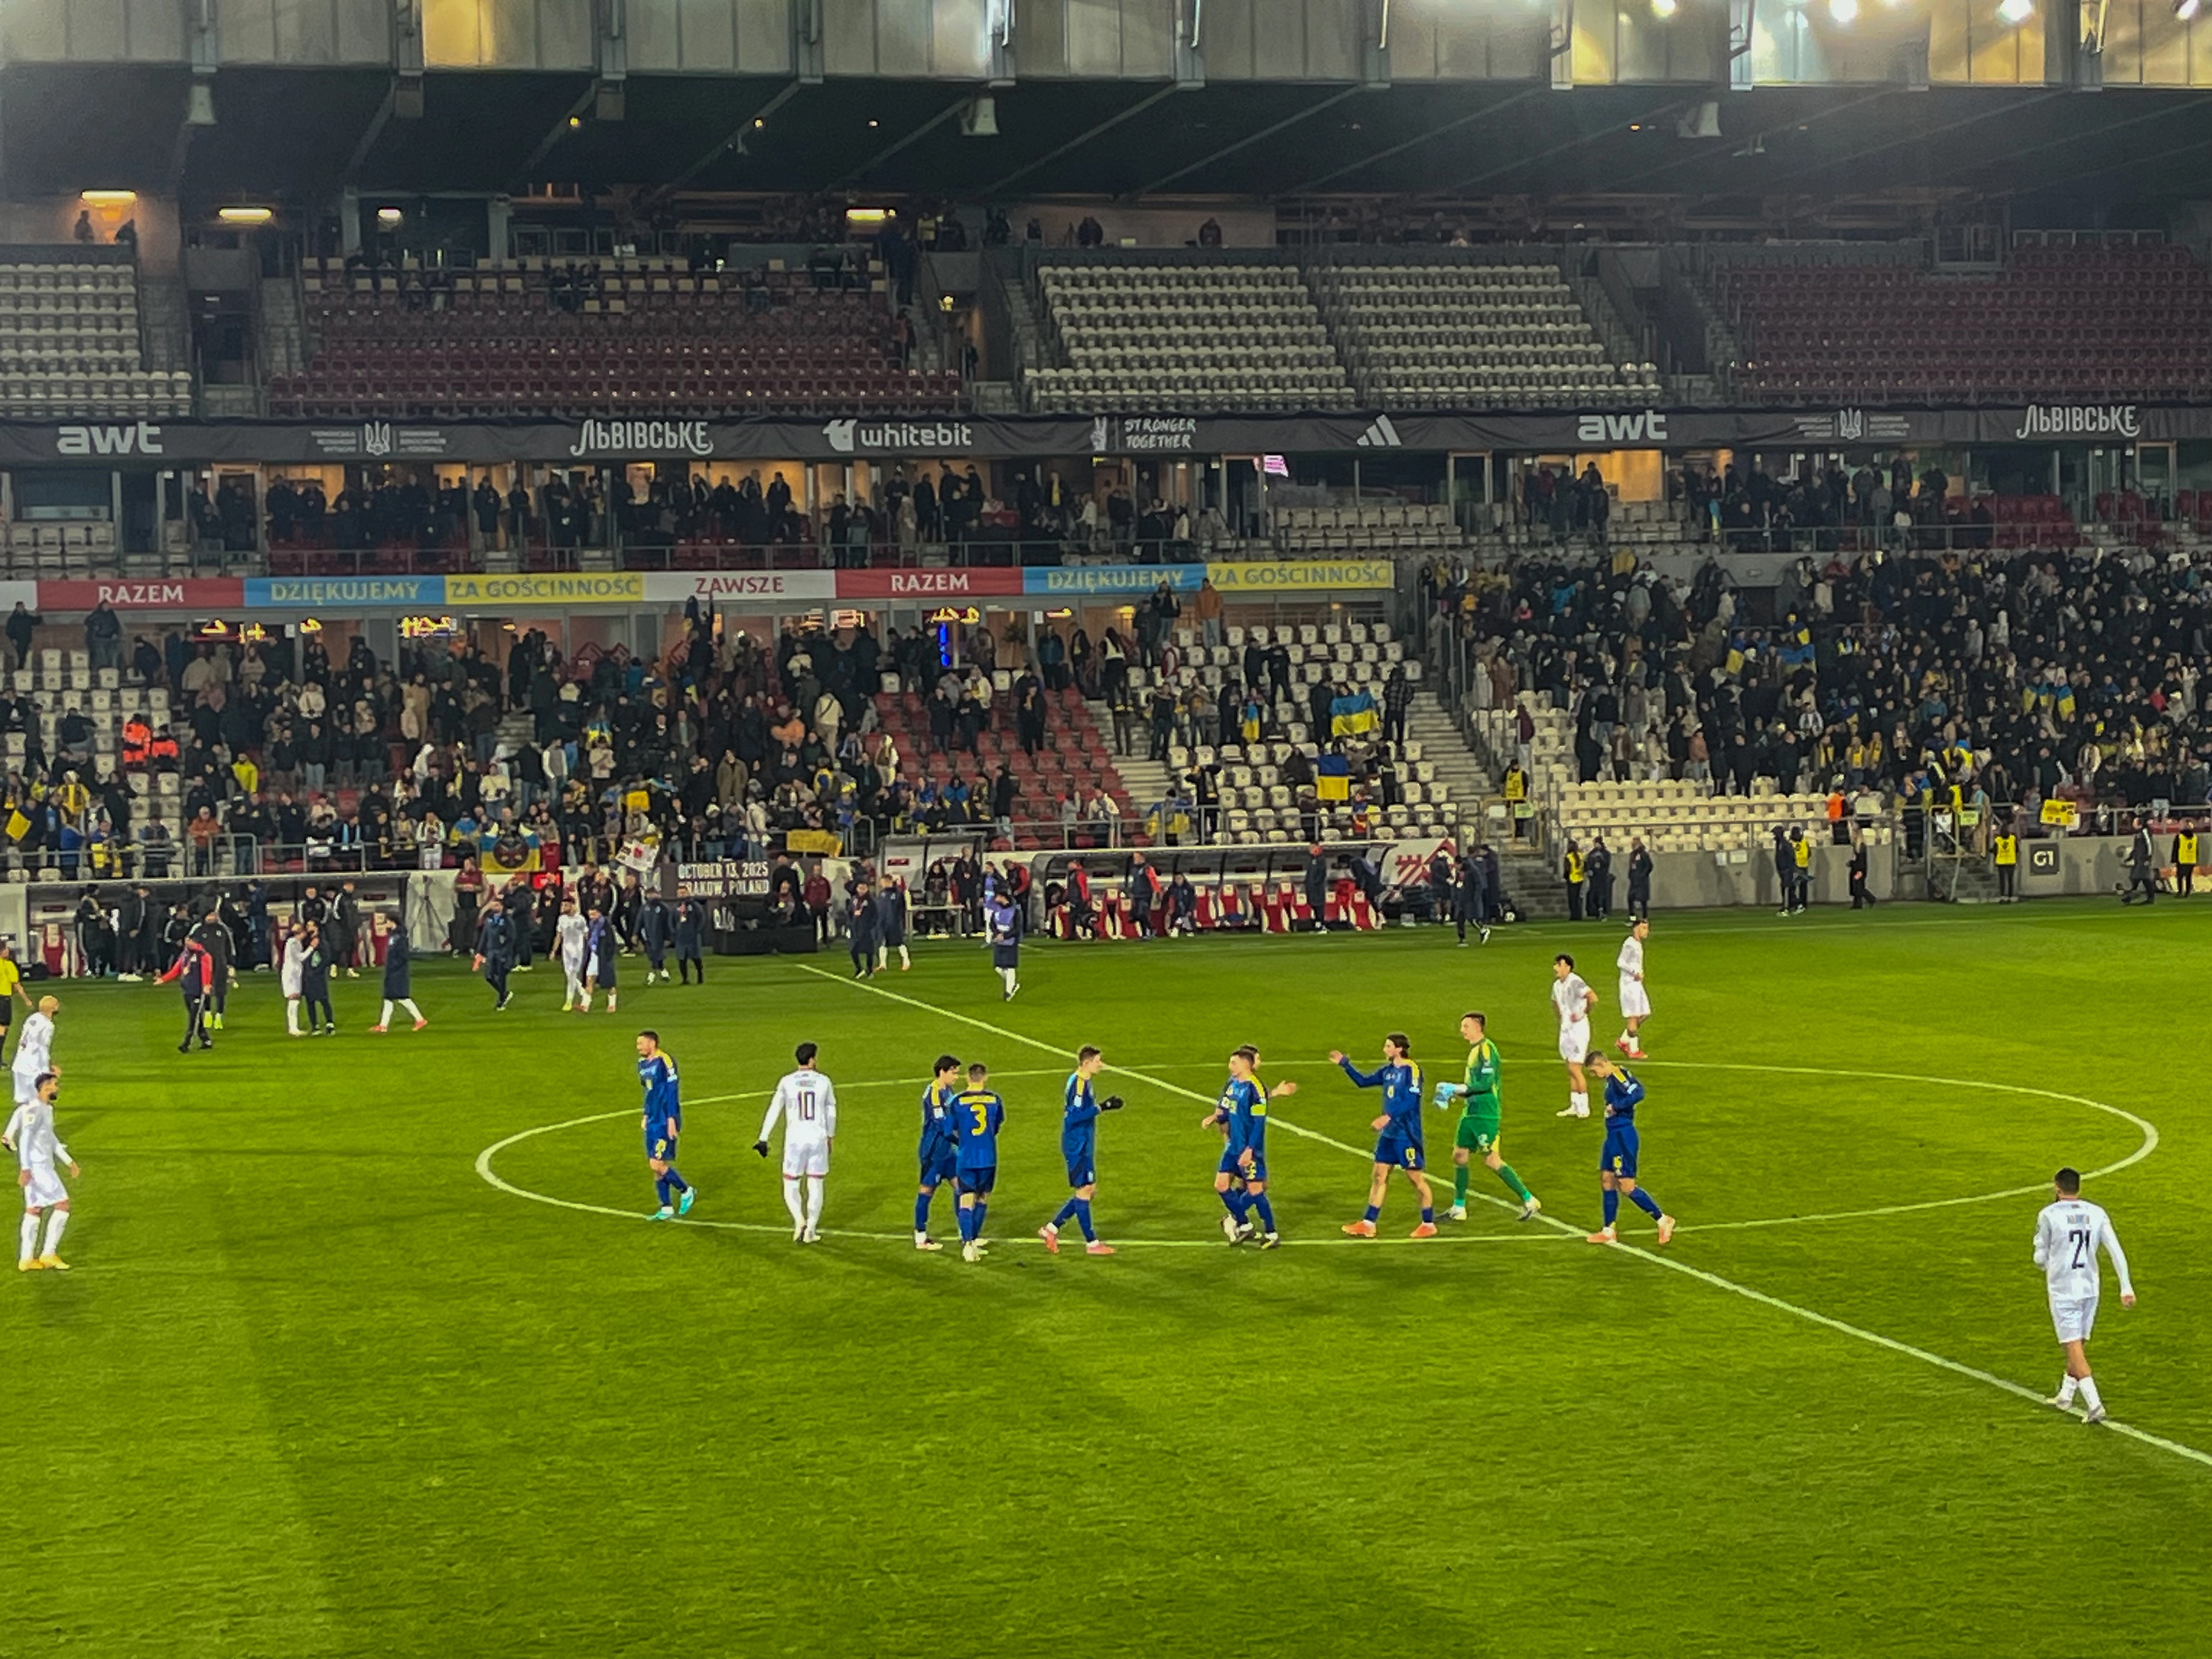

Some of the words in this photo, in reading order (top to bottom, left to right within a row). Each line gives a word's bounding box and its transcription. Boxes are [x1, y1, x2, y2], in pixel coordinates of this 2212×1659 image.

[1124, 418, 1196, 433] STRONGER
[1577, 410, 1667, 440] awt
[58, 422, 163, 454] awt
[861, 423, 972, 447] whitebit
[1126, 433, 1192, 449] TOGETHER
[891, 574, 969, 592] RAZEM
[1213, 569, 1238, 584] ZA
[99, 585, 184, 603] RAZEM
[449, 582, 479, 597] ZA
[695, 577, 784, 594] ZAWSZE
[2033, 851, 2054, 866] G1
[679, 863, 723, 879] OCTOBER
[741, 862, 769, 877] 2025
[729, 880, 770, 895] POLAND
[797, 1090, 816, 1121] 10
[969, 1103, 987, 1137] 3
